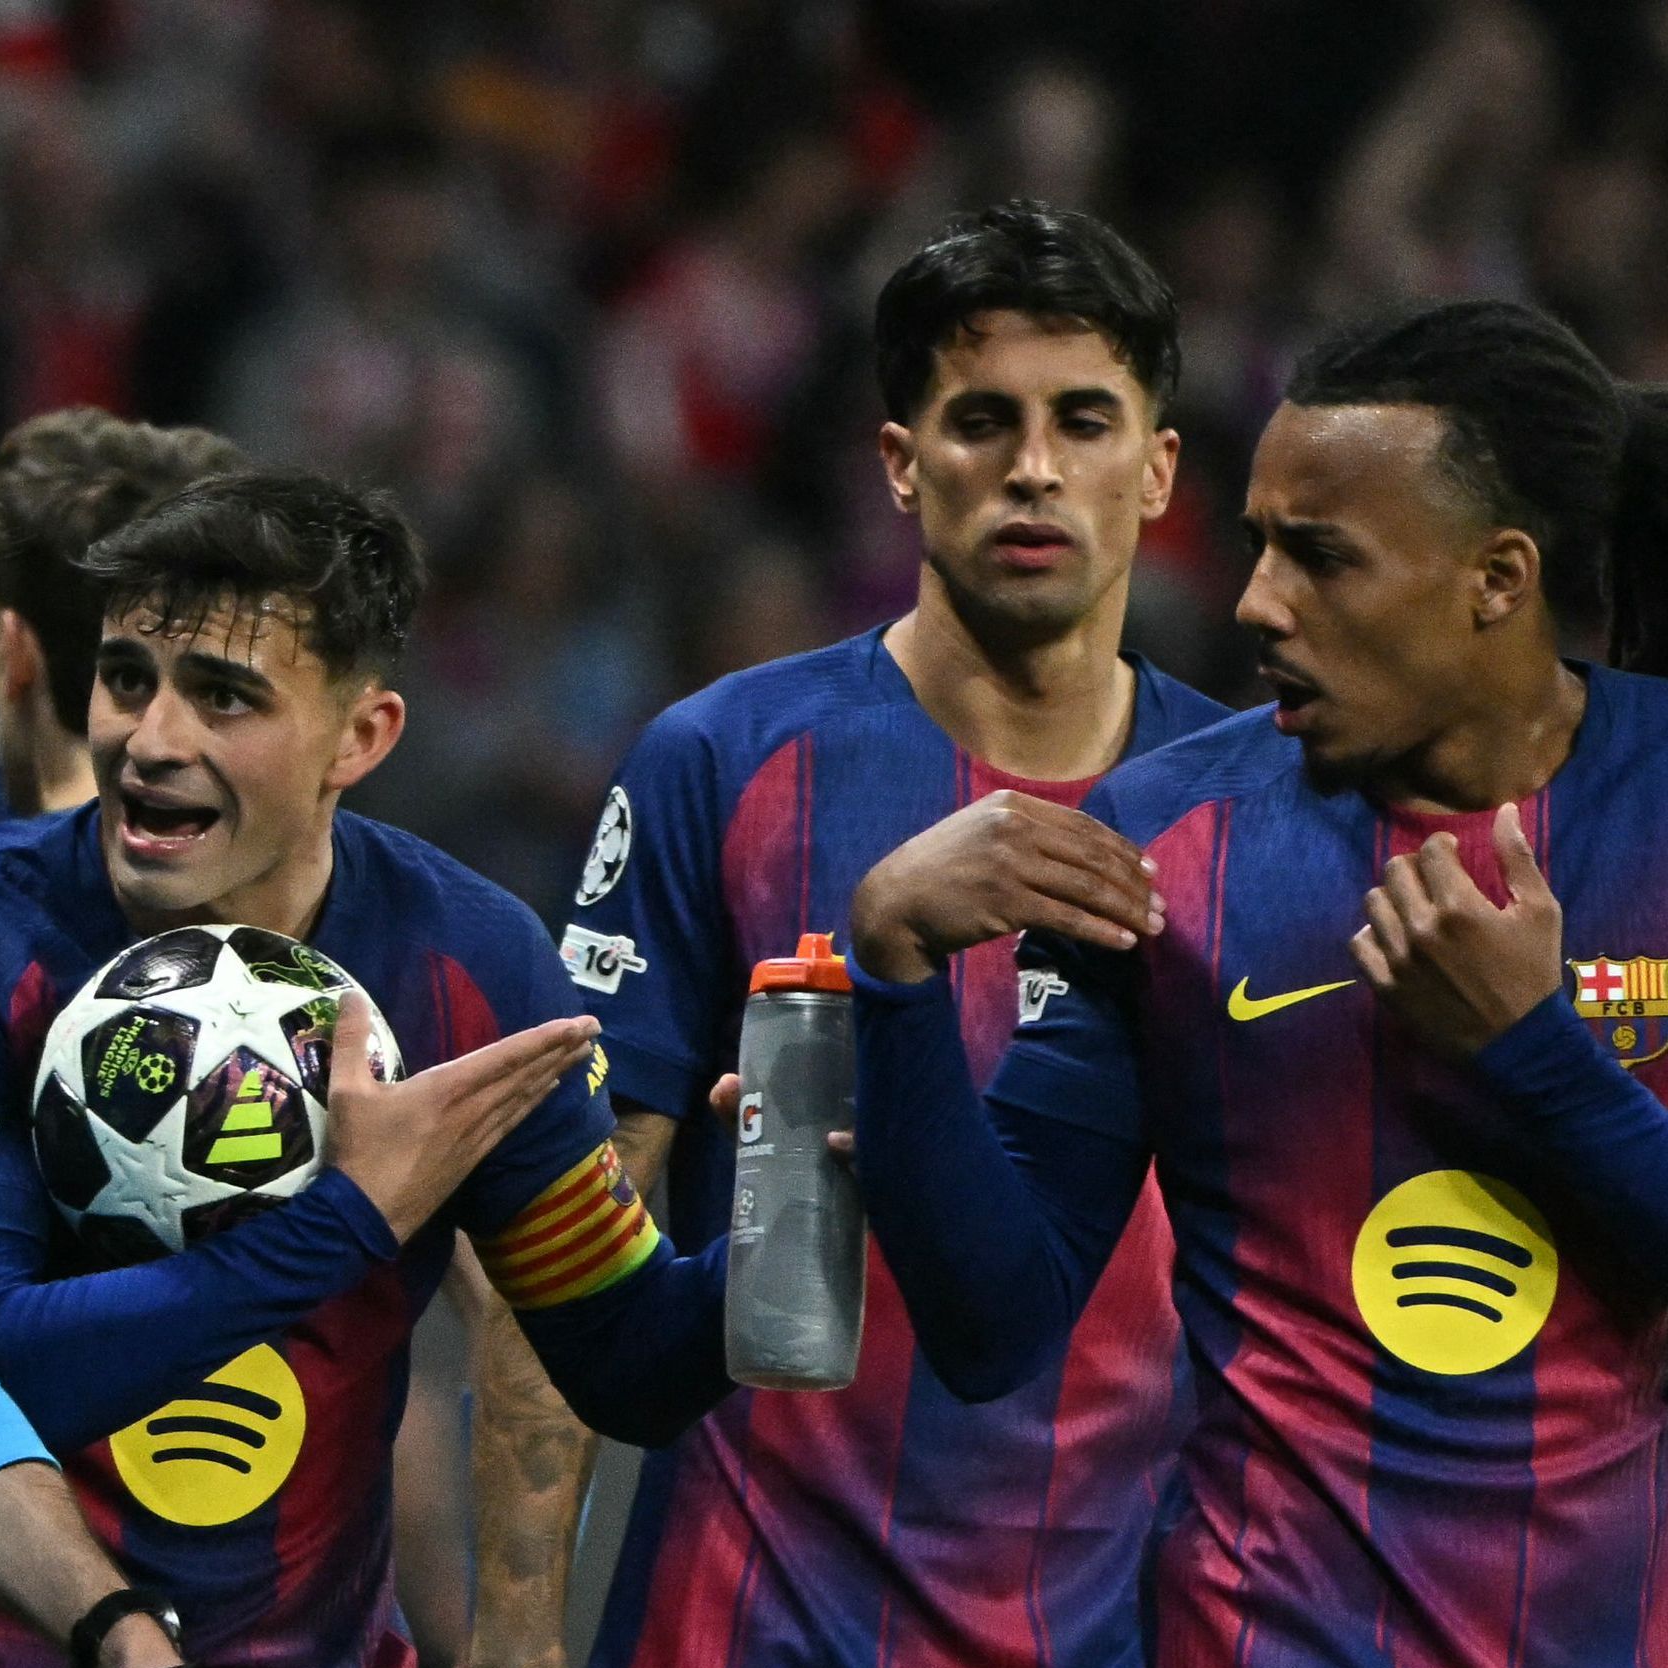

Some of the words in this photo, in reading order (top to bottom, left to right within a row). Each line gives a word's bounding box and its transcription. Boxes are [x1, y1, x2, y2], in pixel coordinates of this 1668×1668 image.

[96, 1027, 128, 1079] LEAGUE
[99, 1016, 146, 1098] CHAMPIONS
[739, 1091, 763, 1143] G
